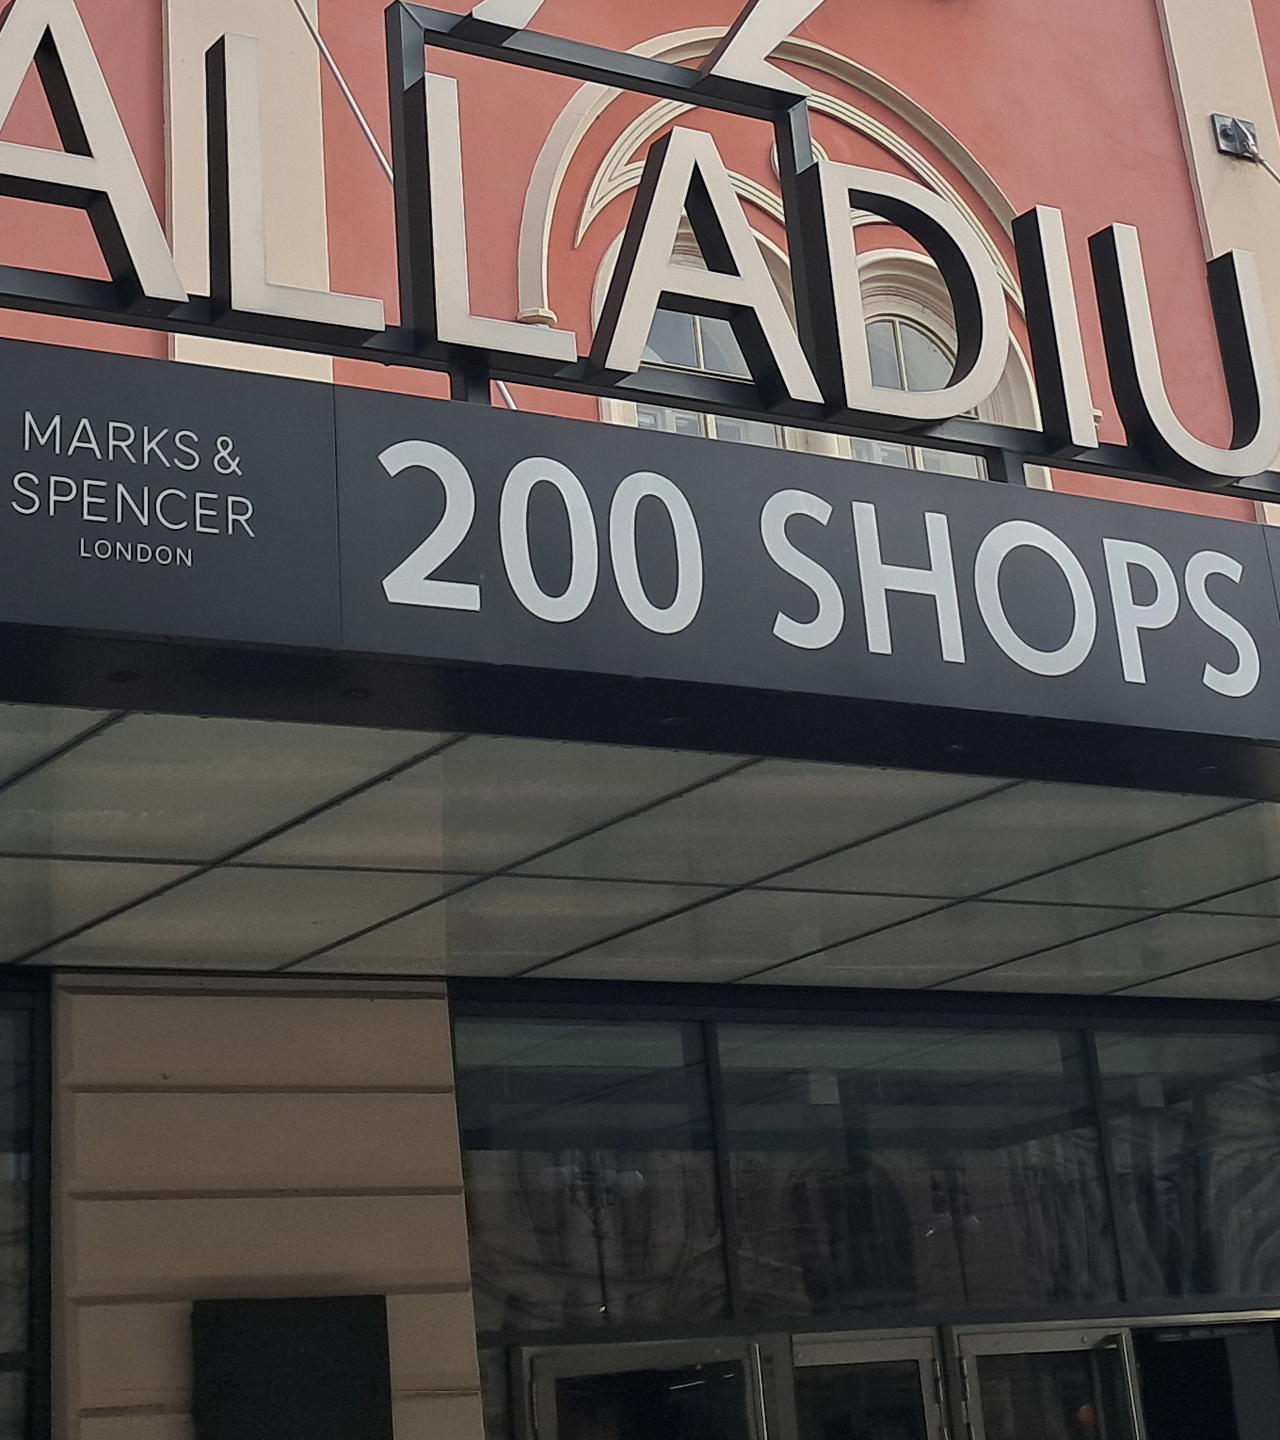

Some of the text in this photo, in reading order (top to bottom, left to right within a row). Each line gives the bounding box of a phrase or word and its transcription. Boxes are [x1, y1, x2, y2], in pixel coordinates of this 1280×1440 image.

[23, 410, 243, 477] MARKS &
[11, 471, 257, 537] SPENCER
[80, 537, 194, 567] LONDON
[377, 439, 1262, 699] 200 SHOPS
